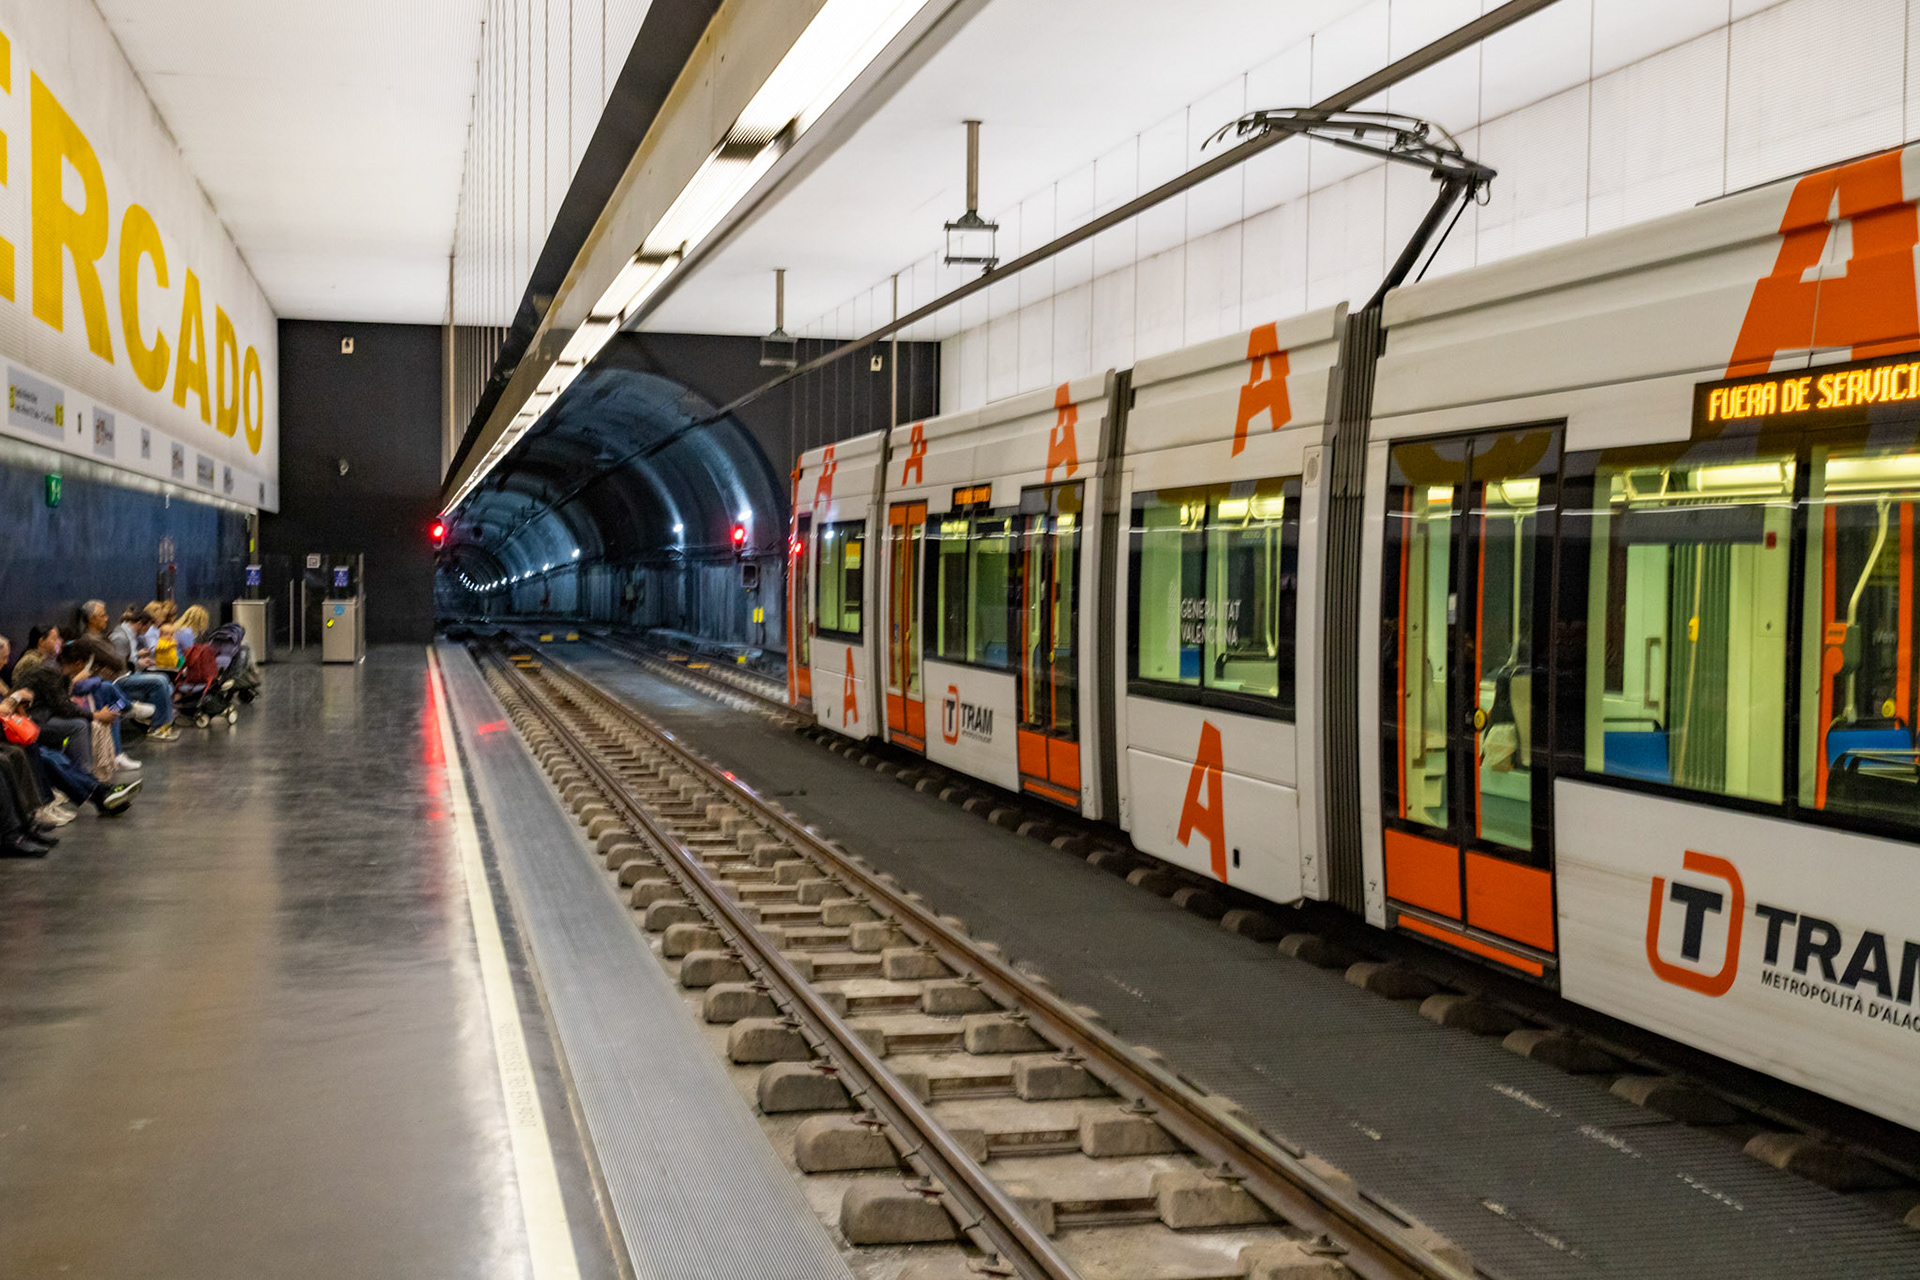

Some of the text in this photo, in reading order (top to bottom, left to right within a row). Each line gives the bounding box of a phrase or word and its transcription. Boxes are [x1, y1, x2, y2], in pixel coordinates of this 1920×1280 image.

[0, 30, 263, 456] RCADO
[1708, 361, 1920, 421] FUERA DE SERVICI
[1181, 597, 1242, 621] GENERATAT
[961, 703, 993, 736] TRAM
[1761, 970, 1863, 1014] METROPOLITÀ
